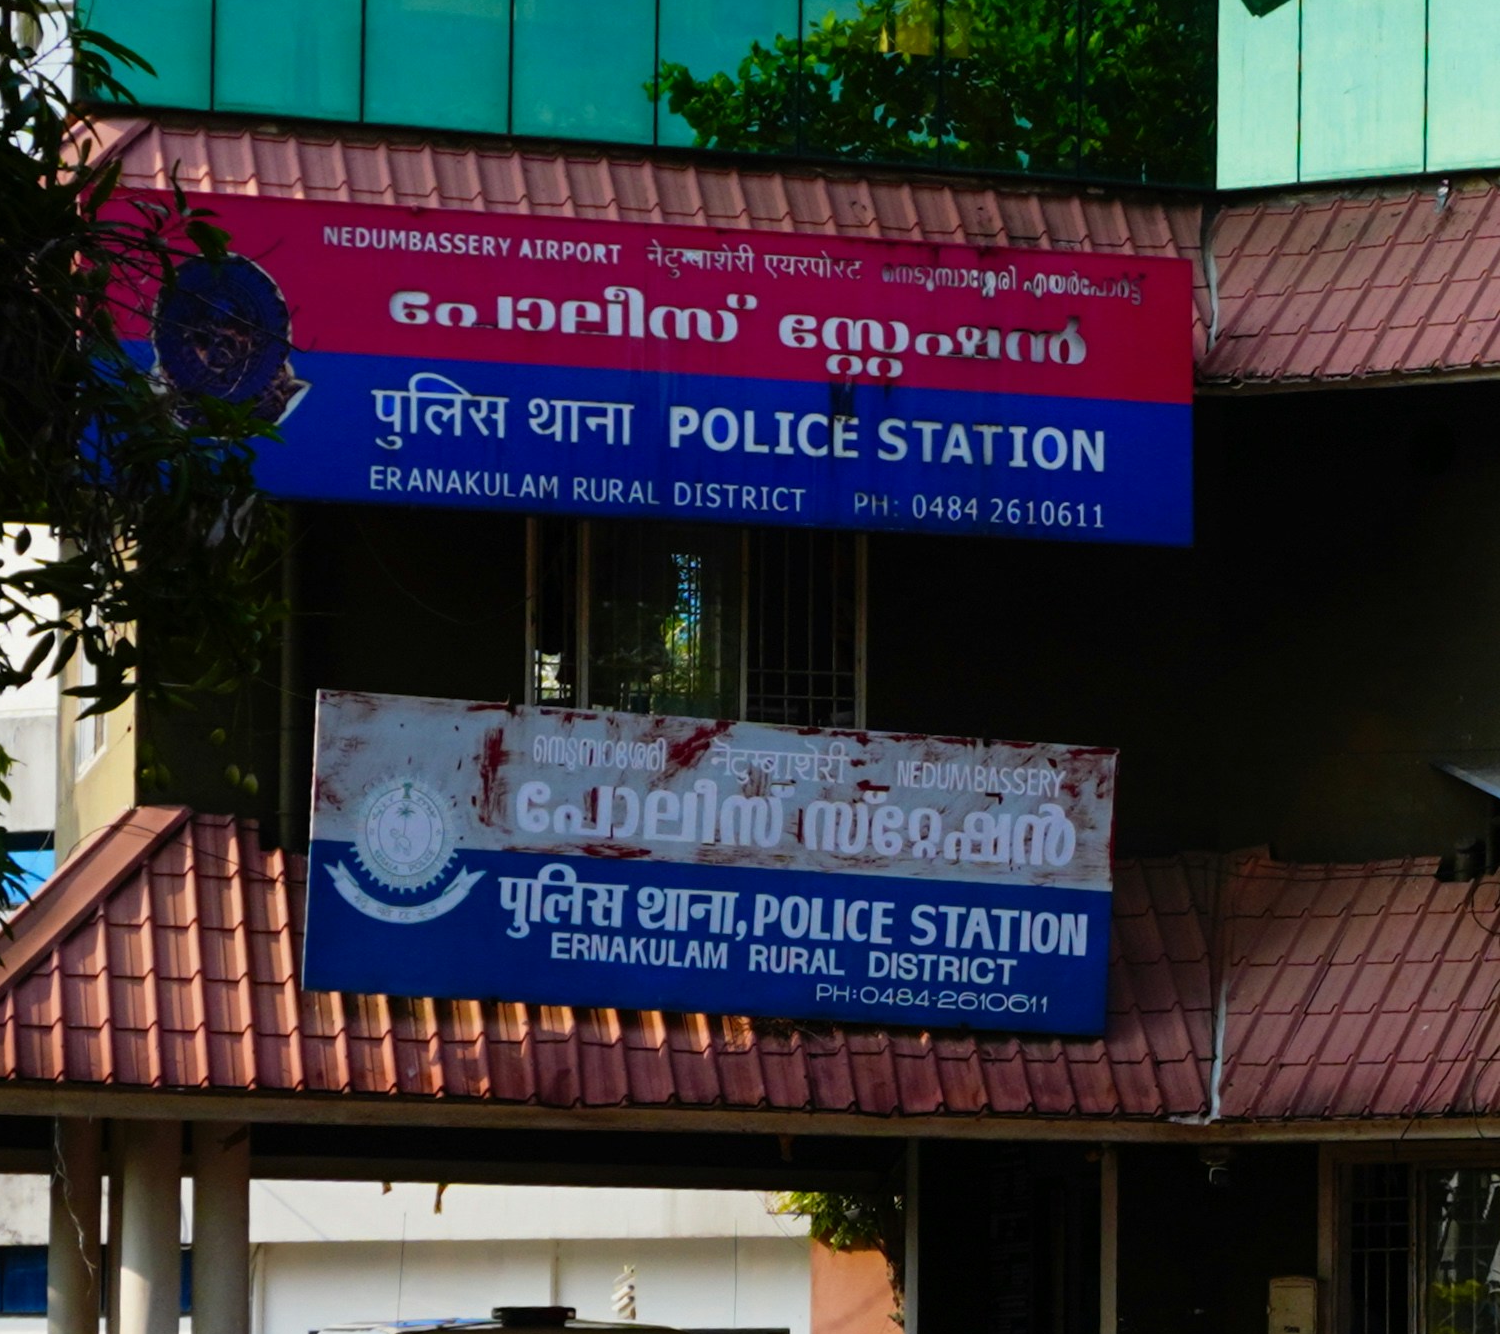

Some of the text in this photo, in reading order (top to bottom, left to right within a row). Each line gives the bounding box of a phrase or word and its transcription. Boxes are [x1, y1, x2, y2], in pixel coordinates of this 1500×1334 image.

[323, 226, 622, 265] NEDUMBASSERY AIRPORT
[389, 285, 1088, 378] പോലീസ് സ്റ്റേഷൻ
[370, 372, 635, 450] पुलिस थाना
[669, 405, 1106, 472] POLICE STATION
[369, 465, 807, 513] ERANAKULAM RURAL DISTRICT
[854, 492, 1105, 529] PH: 0484 2610611
[897, 760, 1066, 797] NEDUMBASSERY
[516, 778, 1077, 867] പോലീസ് സ്റ്റേഷൻ
[498, 863, 629, 939] पुलिस
[636, 886, 748, 941] थाना,
[752, 893, 1089, 956] POLICE STATION
[551, 931, 1018, 986] ERNAKULAM RURAL DISTRICT
[815, 984, 1049, 1014] PH:0484-2610611
